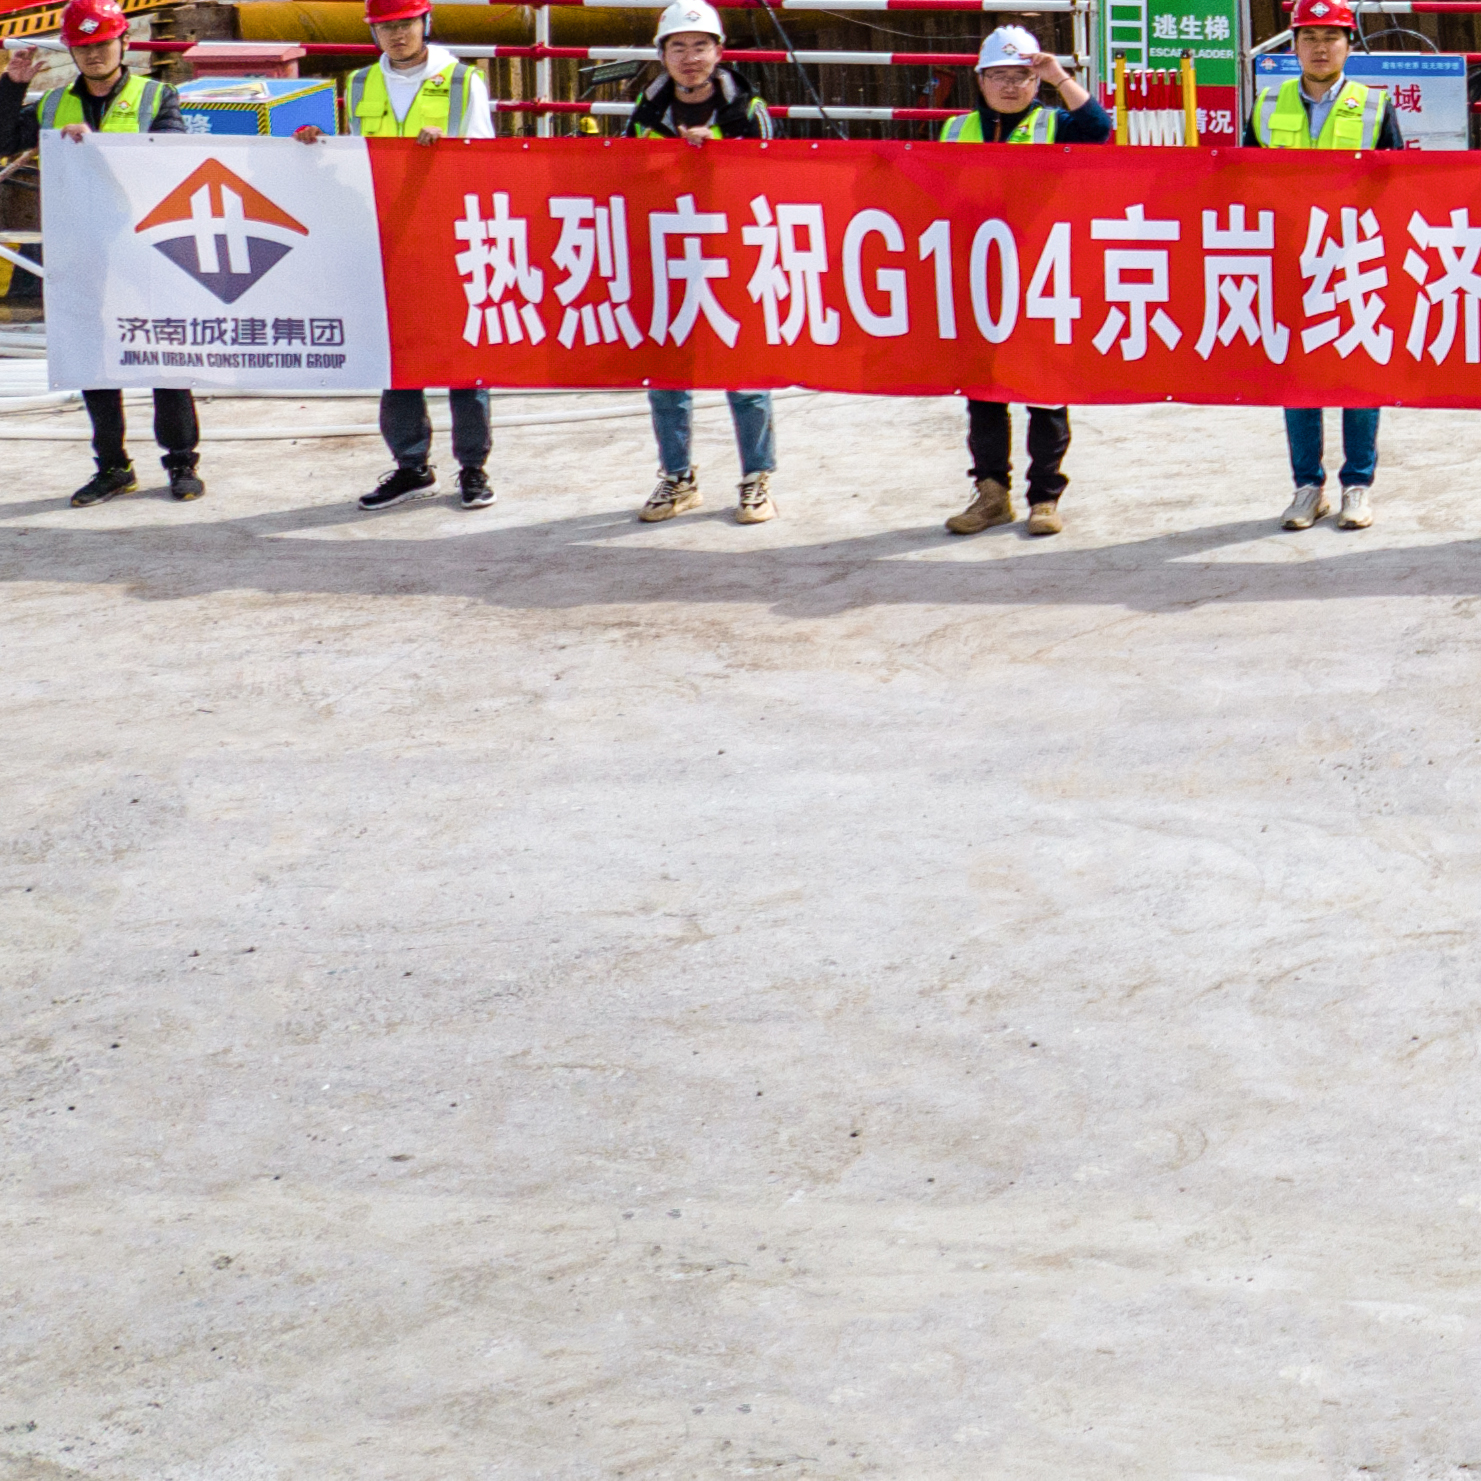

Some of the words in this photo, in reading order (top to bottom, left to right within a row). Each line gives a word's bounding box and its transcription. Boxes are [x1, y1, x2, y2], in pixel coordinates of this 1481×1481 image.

[1152, 14, 1231, 41] 逃生梯
[117, 317, 345, 347] 济南城建集团
[120, 350, 159, 366] JINAN
[162, 351, 204, 367] URBAN
[207, 353, 303, 369] CONSTRUCTION
[306, 354, 347, 369] GROUP
